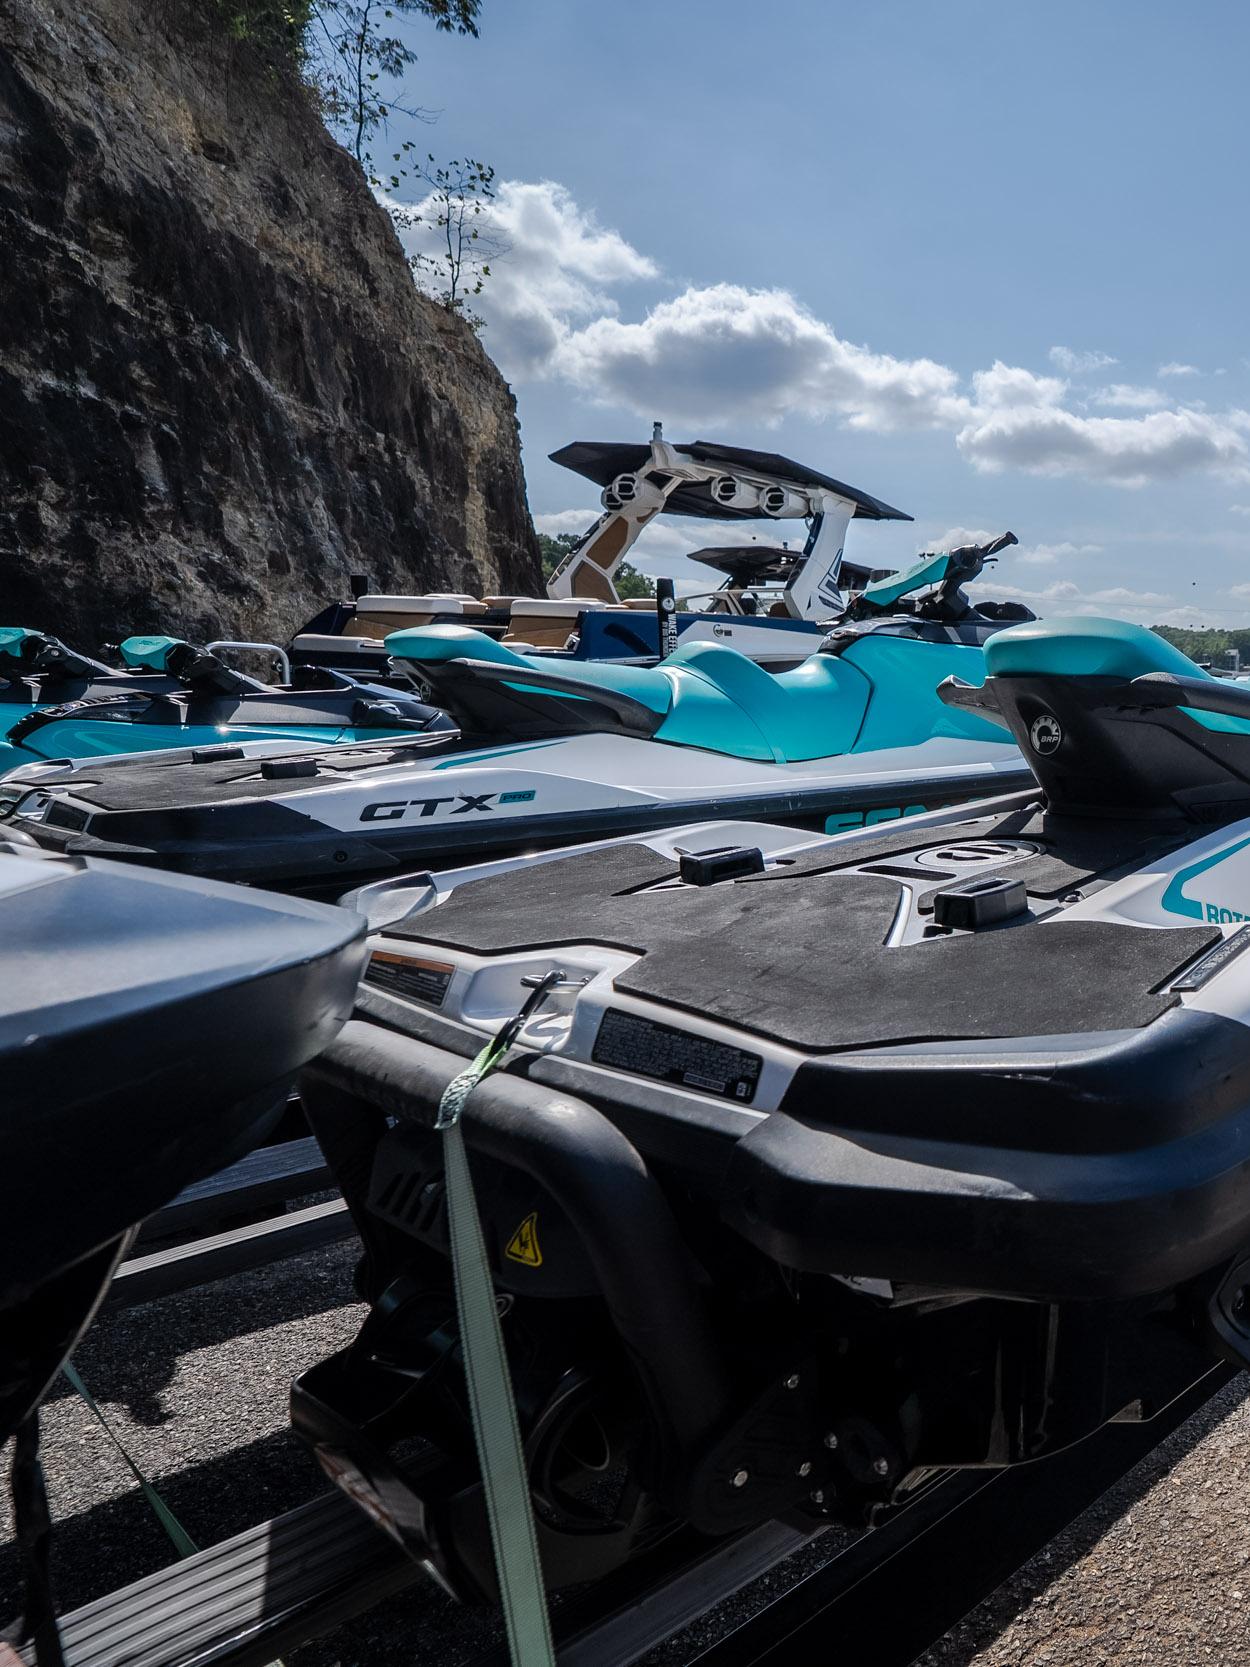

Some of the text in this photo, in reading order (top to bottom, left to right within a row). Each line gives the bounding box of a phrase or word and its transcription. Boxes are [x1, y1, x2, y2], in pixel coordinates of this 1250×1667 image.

[667, 613, 679, 654] WAKE EFFE
[1040, 735, 1059, 743] BRP
[359, 793, 533, 822] GTX PRO
